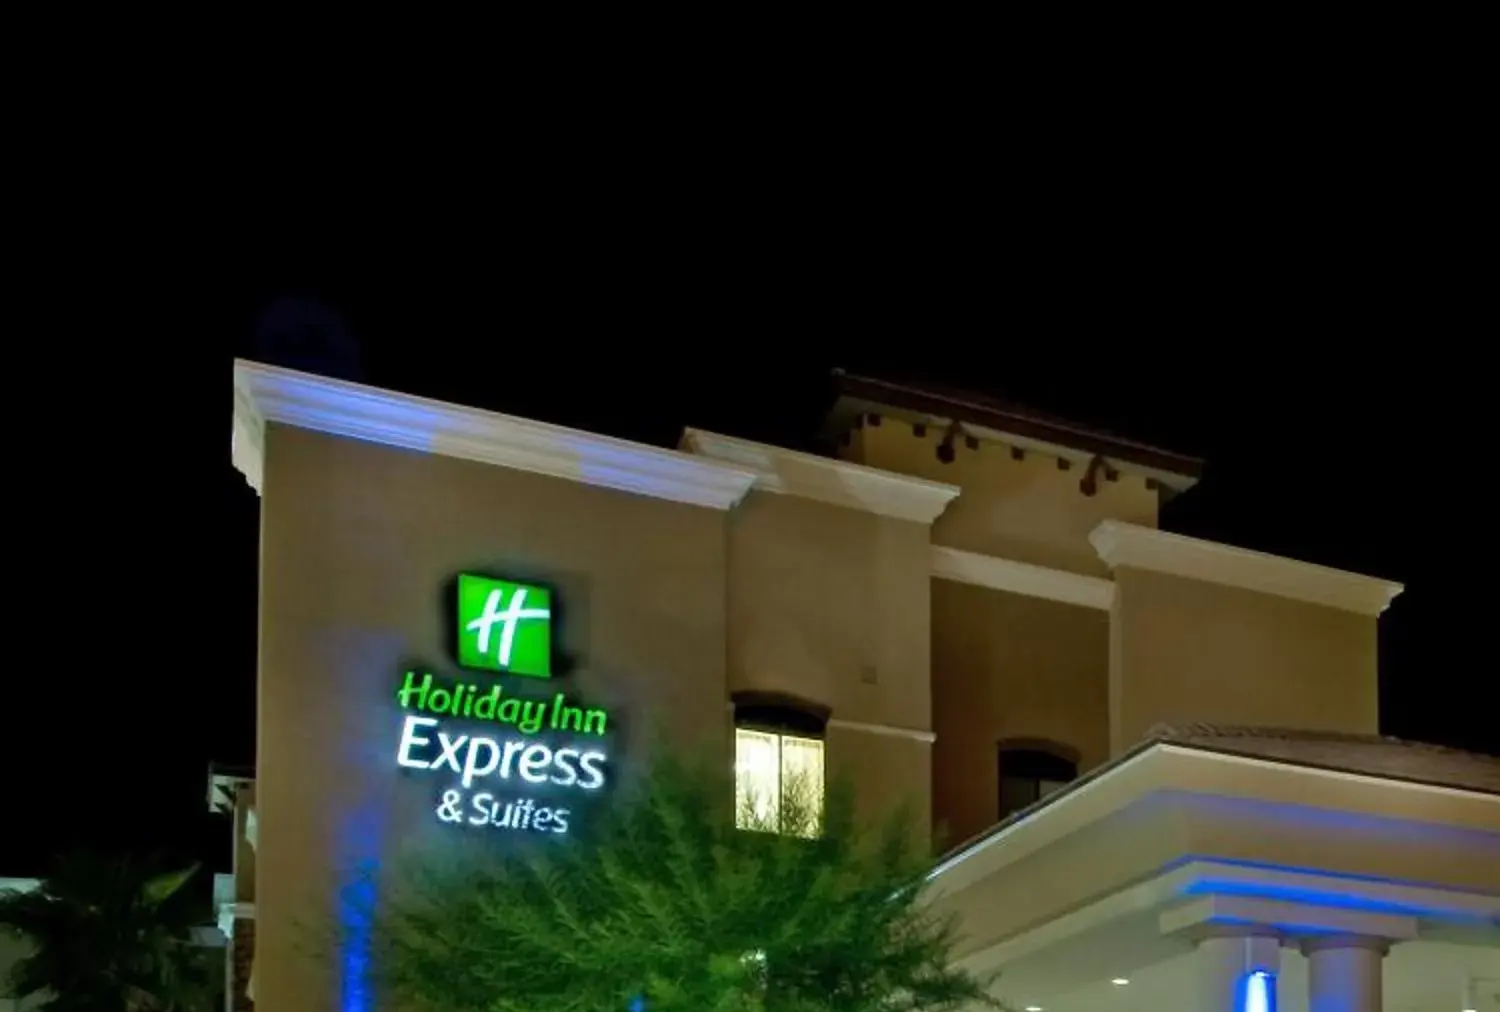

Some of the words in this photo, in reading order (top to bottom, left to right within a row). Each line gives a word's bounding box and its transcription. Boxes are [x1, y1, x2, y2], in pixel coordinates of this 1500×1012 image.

[398, 671, 546, 734] Holiday
[550, 693, 608, 735] Inn
[397, 714, 608, 790] Express
[436, 789, 462, 823] &
[468, 792, 571, 833] Suites
